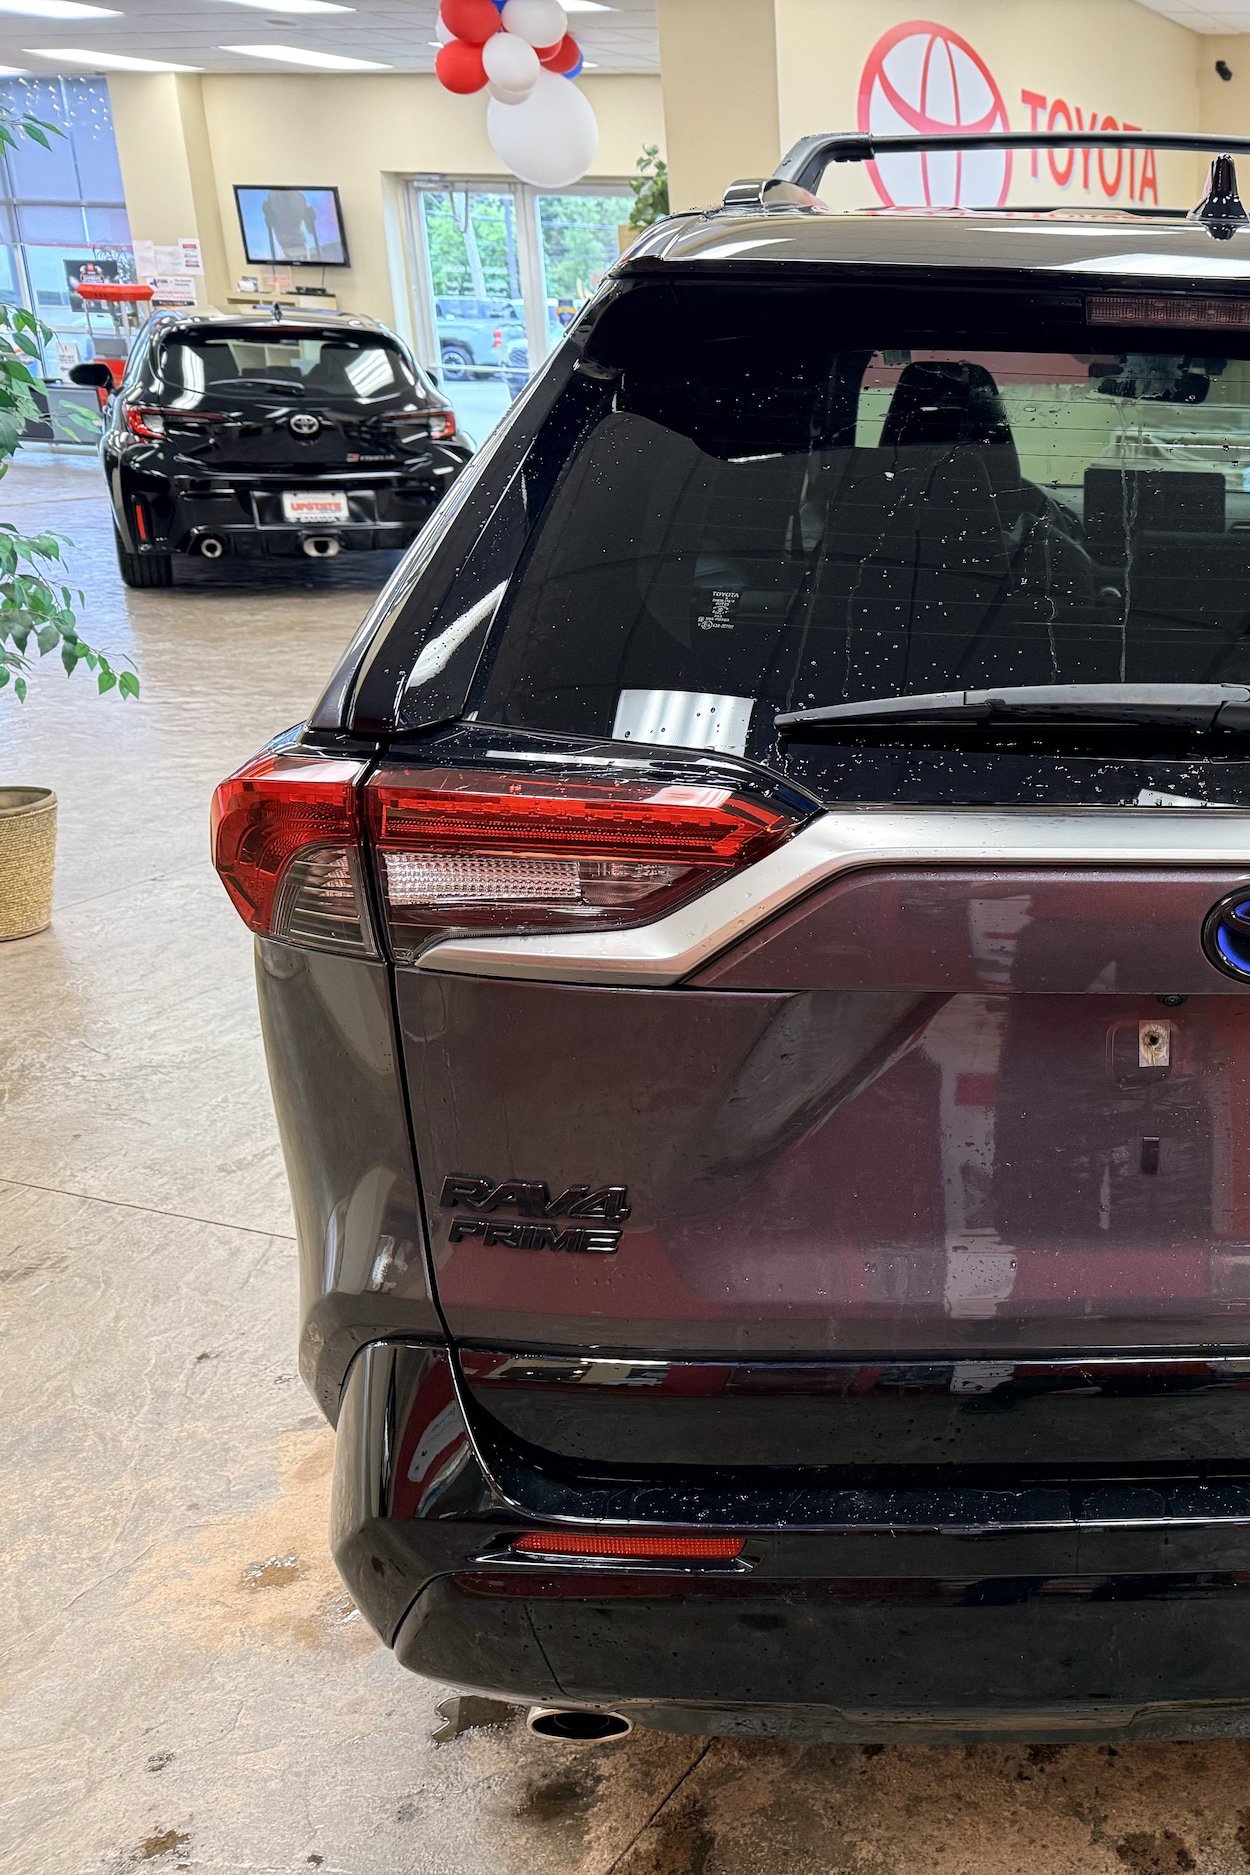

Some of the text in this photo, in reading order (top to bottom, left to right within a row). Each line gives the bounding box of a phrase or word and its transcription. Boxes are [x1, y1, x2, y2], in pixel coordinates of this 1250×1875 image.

[1021, 88, 1158, 206] TOYOTA
[440, 1175, 630, 1223] RAV4
[449, 1218, 623, 1254] PRIME
